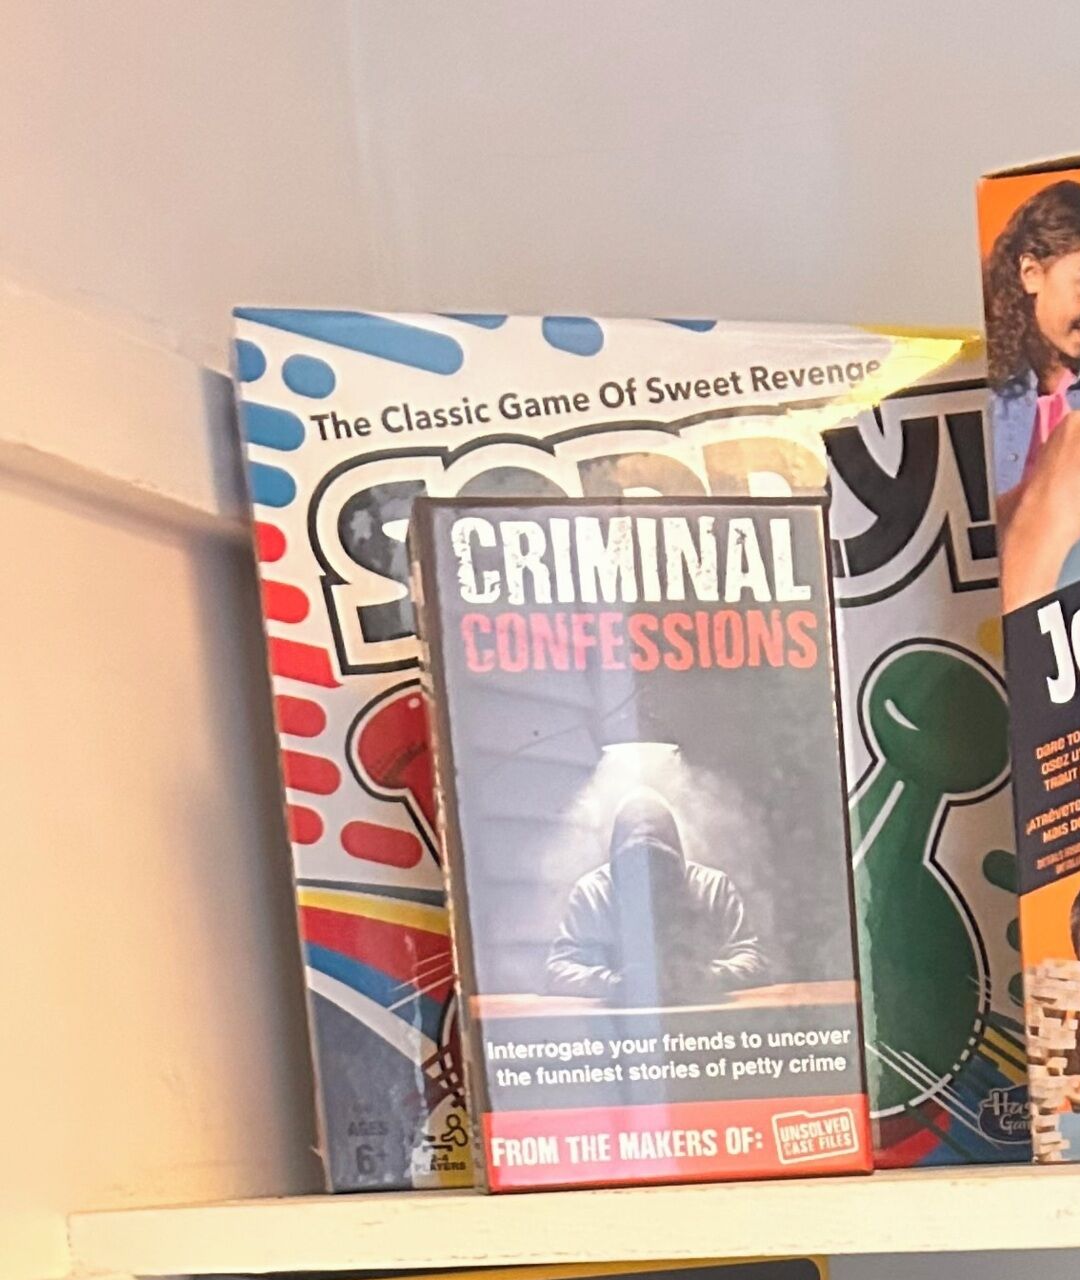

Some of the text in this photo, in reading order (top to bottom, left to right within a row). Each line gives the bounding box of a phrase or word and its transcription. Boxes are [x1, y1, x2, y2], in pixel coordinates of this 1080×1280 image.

[311, 358, 881, 440] The Classic Game Of Sweet Revenge
[452, 515, 811, 604] CRIMINAL
[461, 610, 818, 672] CONFESSIONS
[486, 1028, 851, 1061] Interrogate your friends to uncover
[497, 1053, 846, 1086] the funniest stories of petty crime
[491, 1126, 764, 1166] FROM THE MAKERS OF:
[780, 1116, 850, 1141] UNSOLVED
